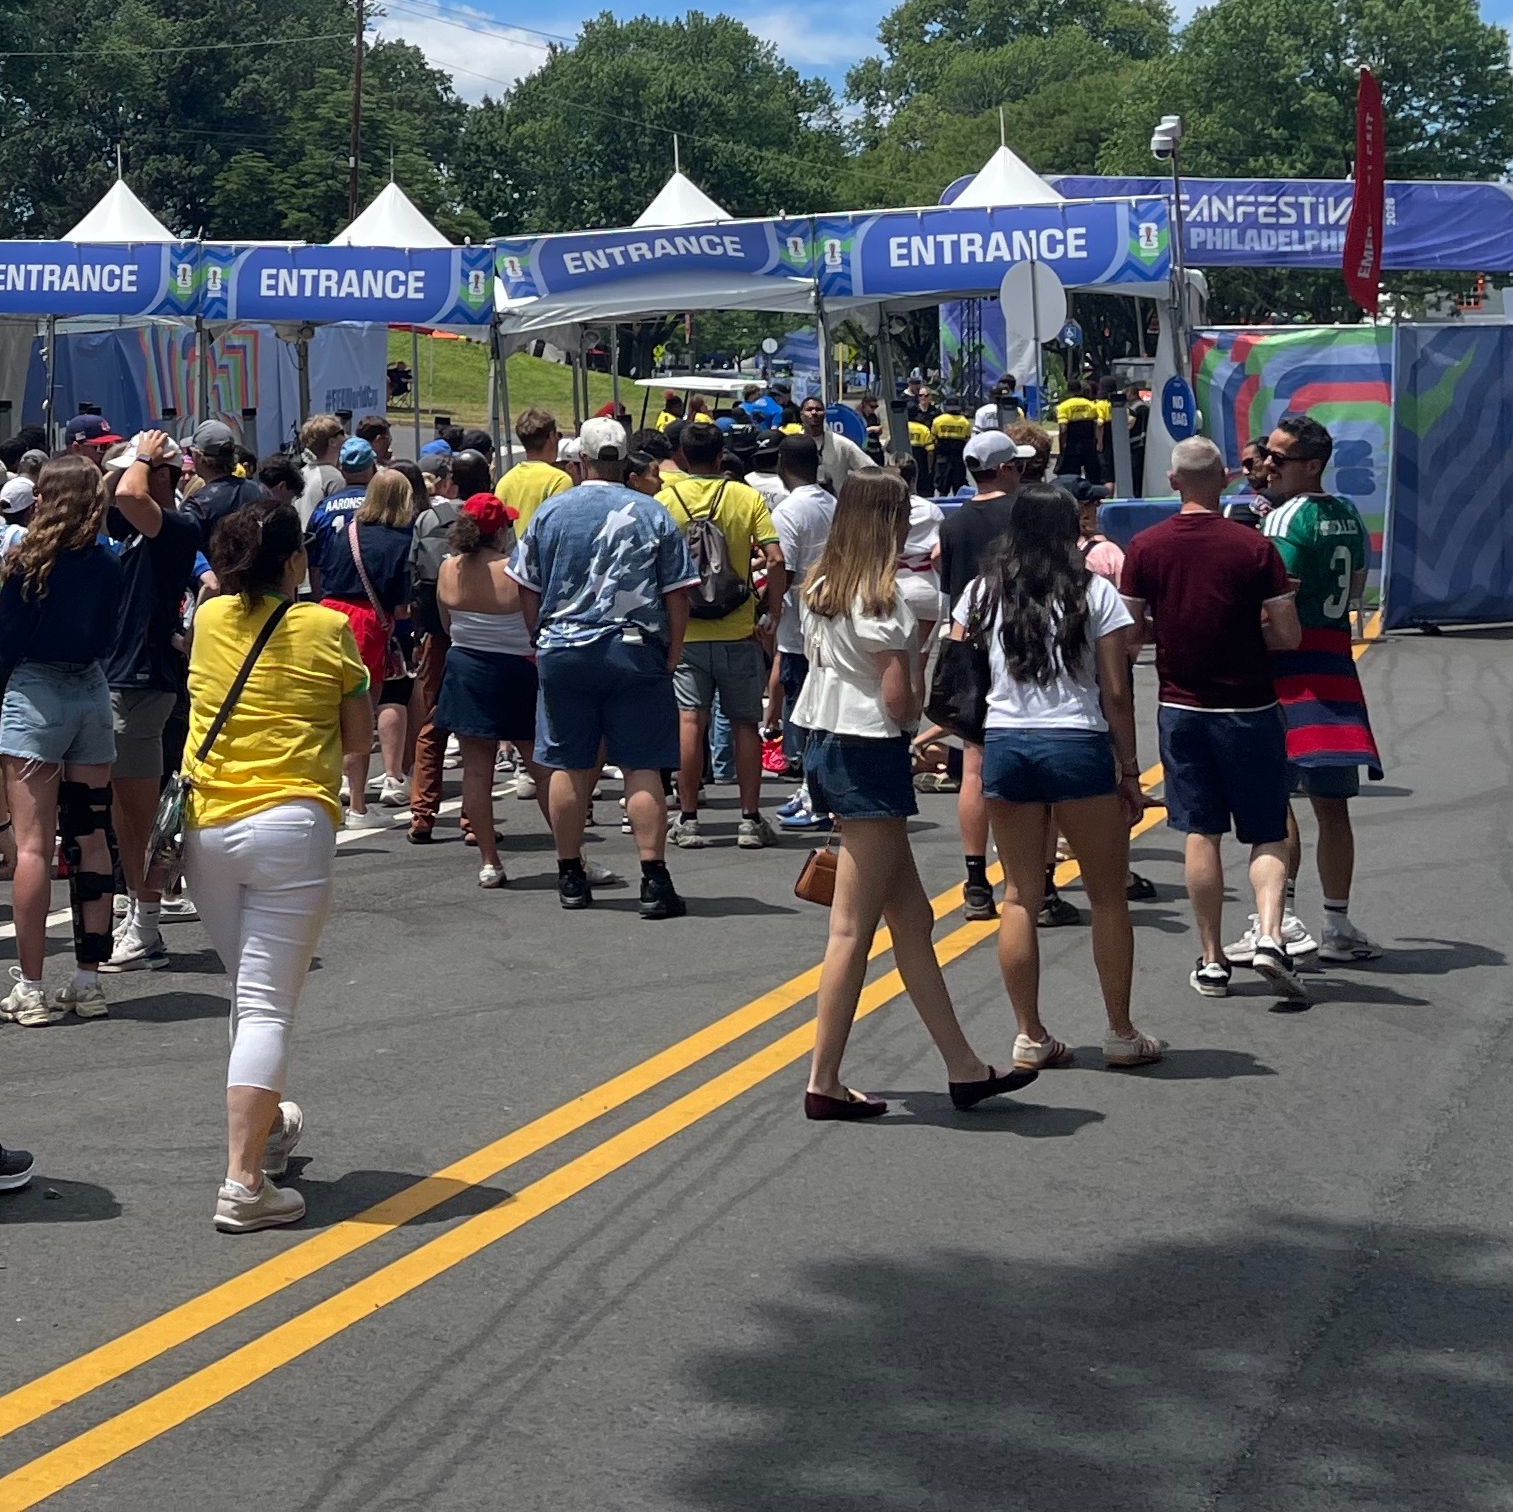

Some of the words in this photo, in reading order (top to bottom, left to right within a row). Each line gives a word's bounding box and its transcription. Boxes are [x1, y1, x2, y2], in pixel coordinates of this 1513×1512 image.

[563, 236, 745, 275] ENTRANCE
[889, 227, 1088, 268] ENTRANCE
[1190, 227, 1345, 252] PHILADELPHI
[260, 268, 426, 300] ENTRANCE
[1172, 396, 1183, 409] NO
[1171, 412, 1187, 426] BAG
[1323, 545, 1351, 619] 3
